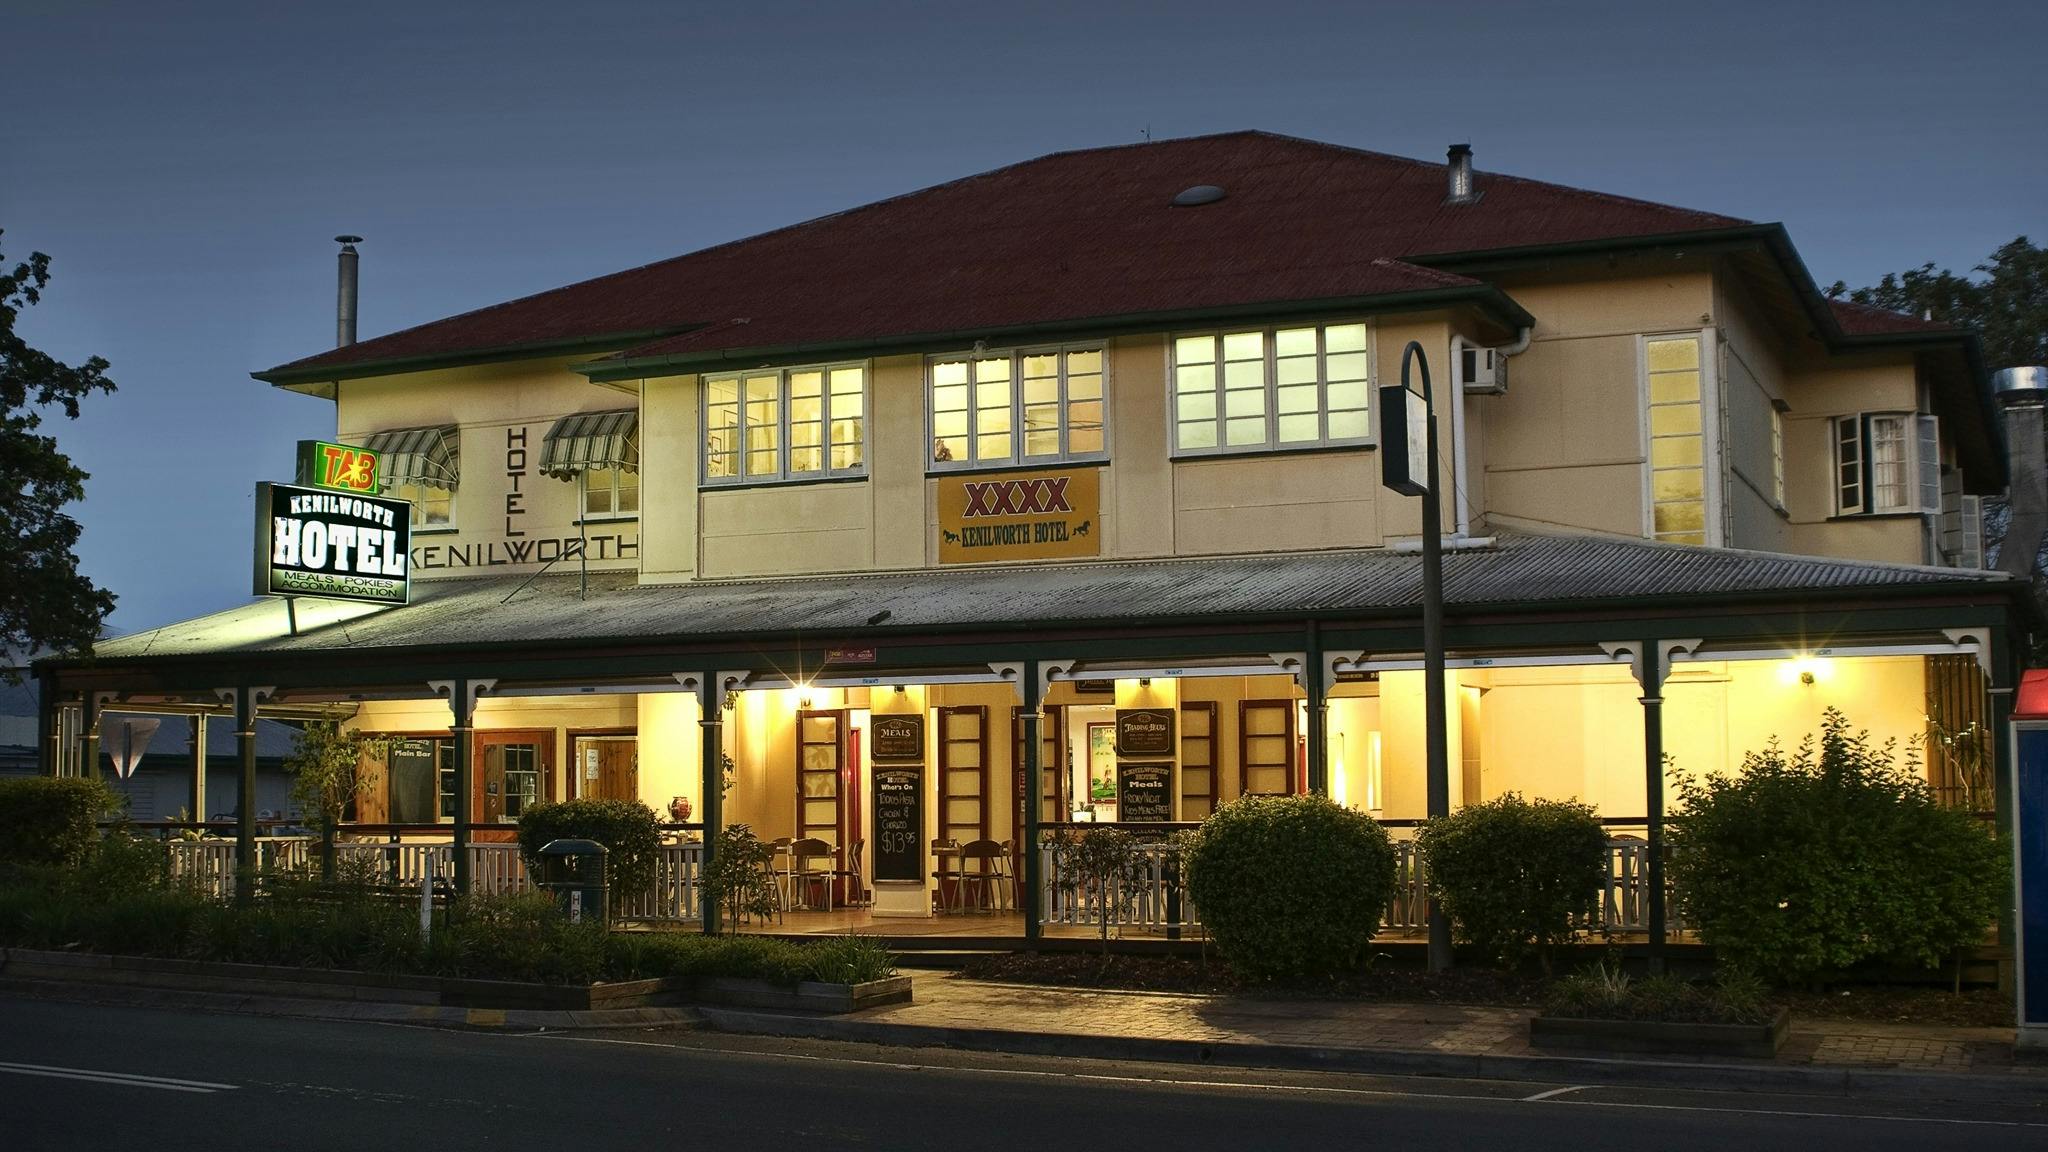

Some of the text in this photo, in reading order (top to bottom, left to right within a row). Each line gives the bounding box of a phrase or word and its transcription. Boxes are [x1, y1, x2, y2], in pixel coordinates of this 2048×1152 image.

[324, 447, 376, 490] TAB
[506, 427, 527, 537] HOTEL
[290, 494, 394, 528] KENILWORTH
[962, 476, 1072, 518] XXXX
[273, 517, 405, 576] HOTEL
[962, 521, 1070, 547] KENILWORTH HOTEL
[281, 580, 398, 597] ACCOMMODATION
[284, 571, 394, 589] MEALS POKIES
[881, 729, 911, 738] MEALS
[1124, 723, 1148, 733] TRADING
[1148, 723, 1166, 732] HOURS
